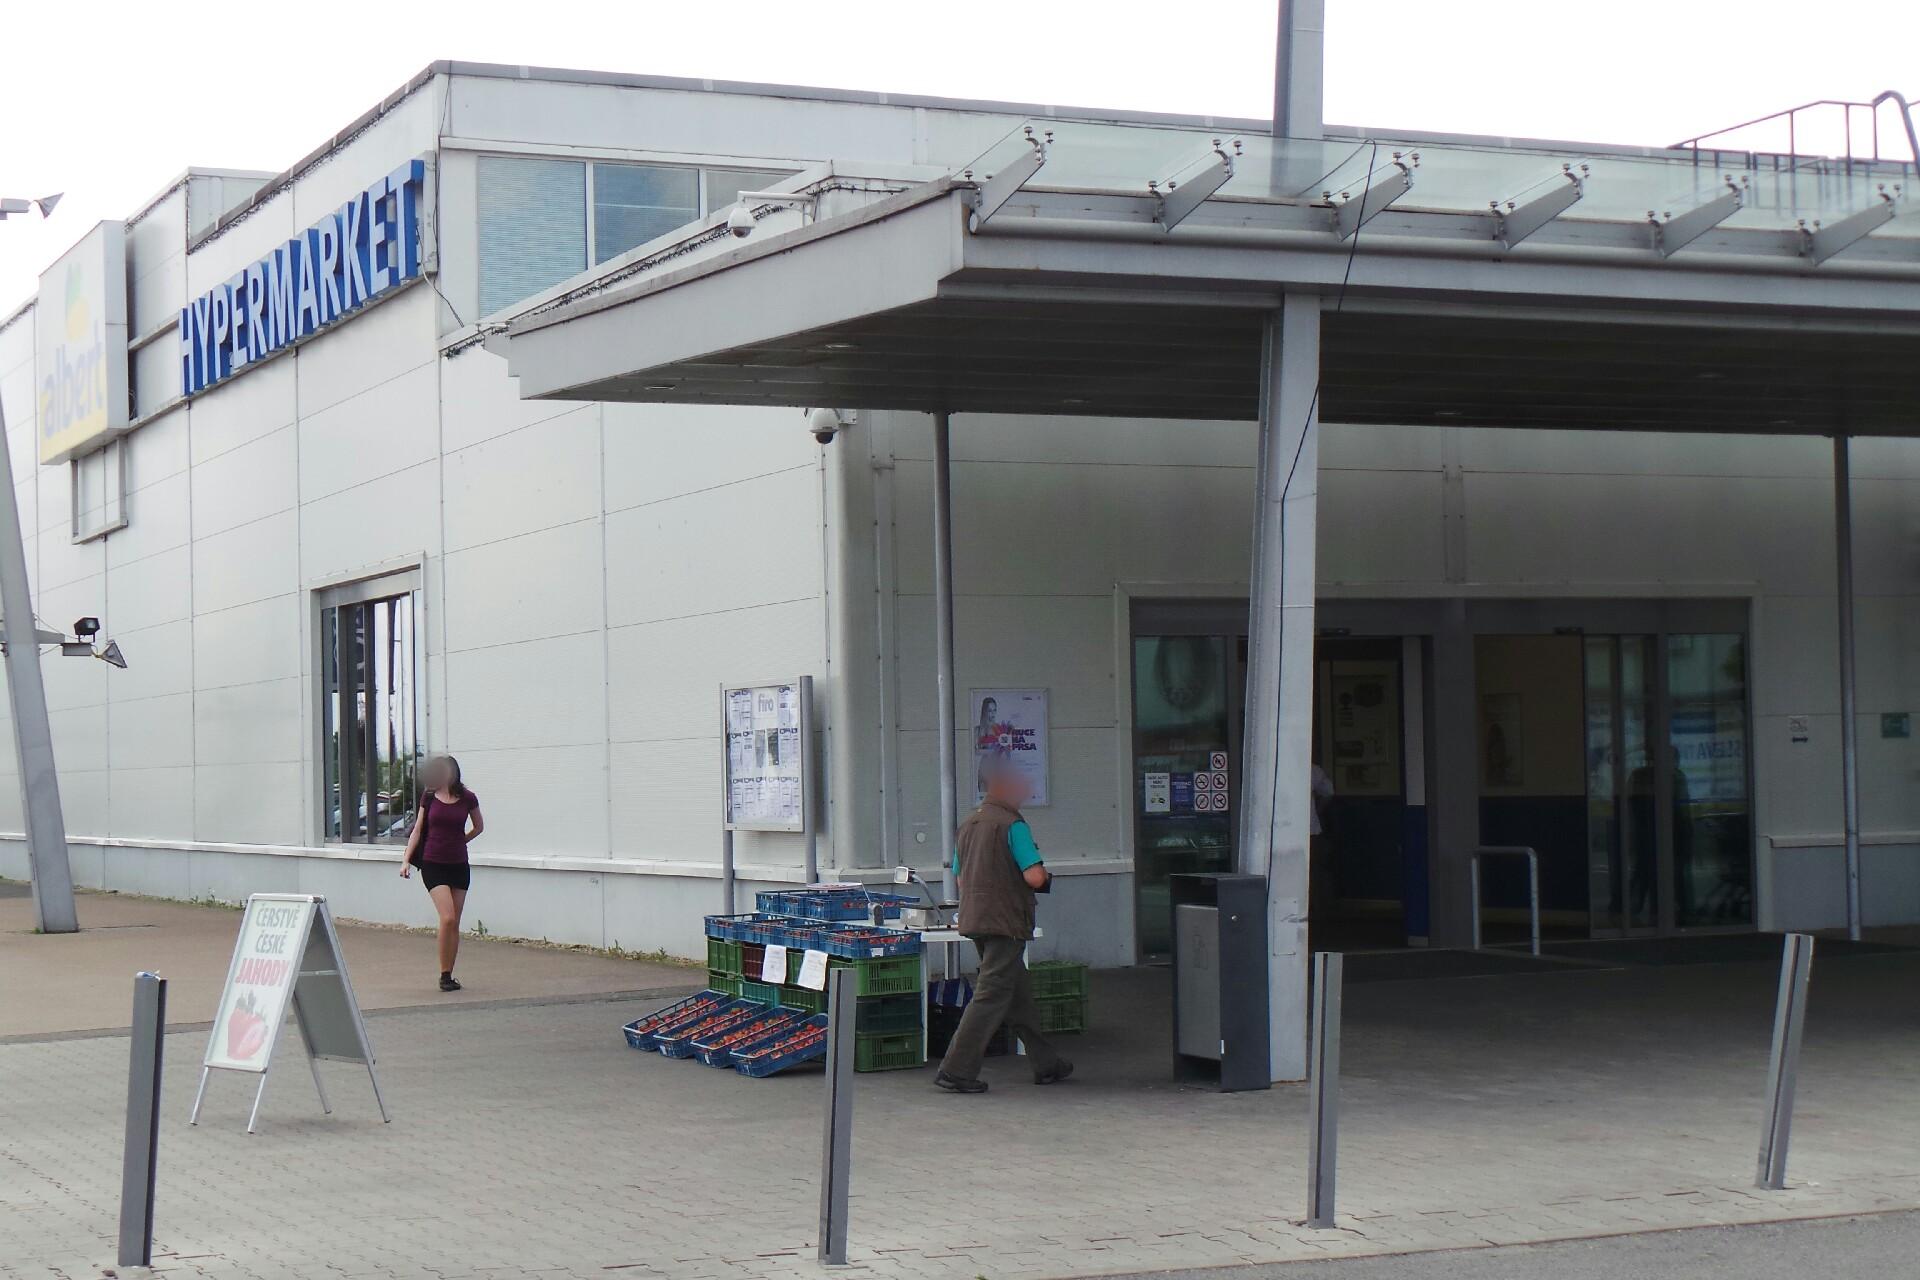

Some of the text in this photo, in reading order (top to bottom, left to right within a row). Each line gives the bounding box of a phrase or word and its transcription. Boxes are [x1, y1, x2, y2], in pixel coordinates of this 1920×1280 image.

[179, 160, 424, 395] HYPERMARKET
[42, 320, 104, 439] albert
[256, 903, 300, 928] ČERSTVÉ
[256, 931, 288, 954] ČESKÉ
[236, 958, 290, 986] JAHODY
